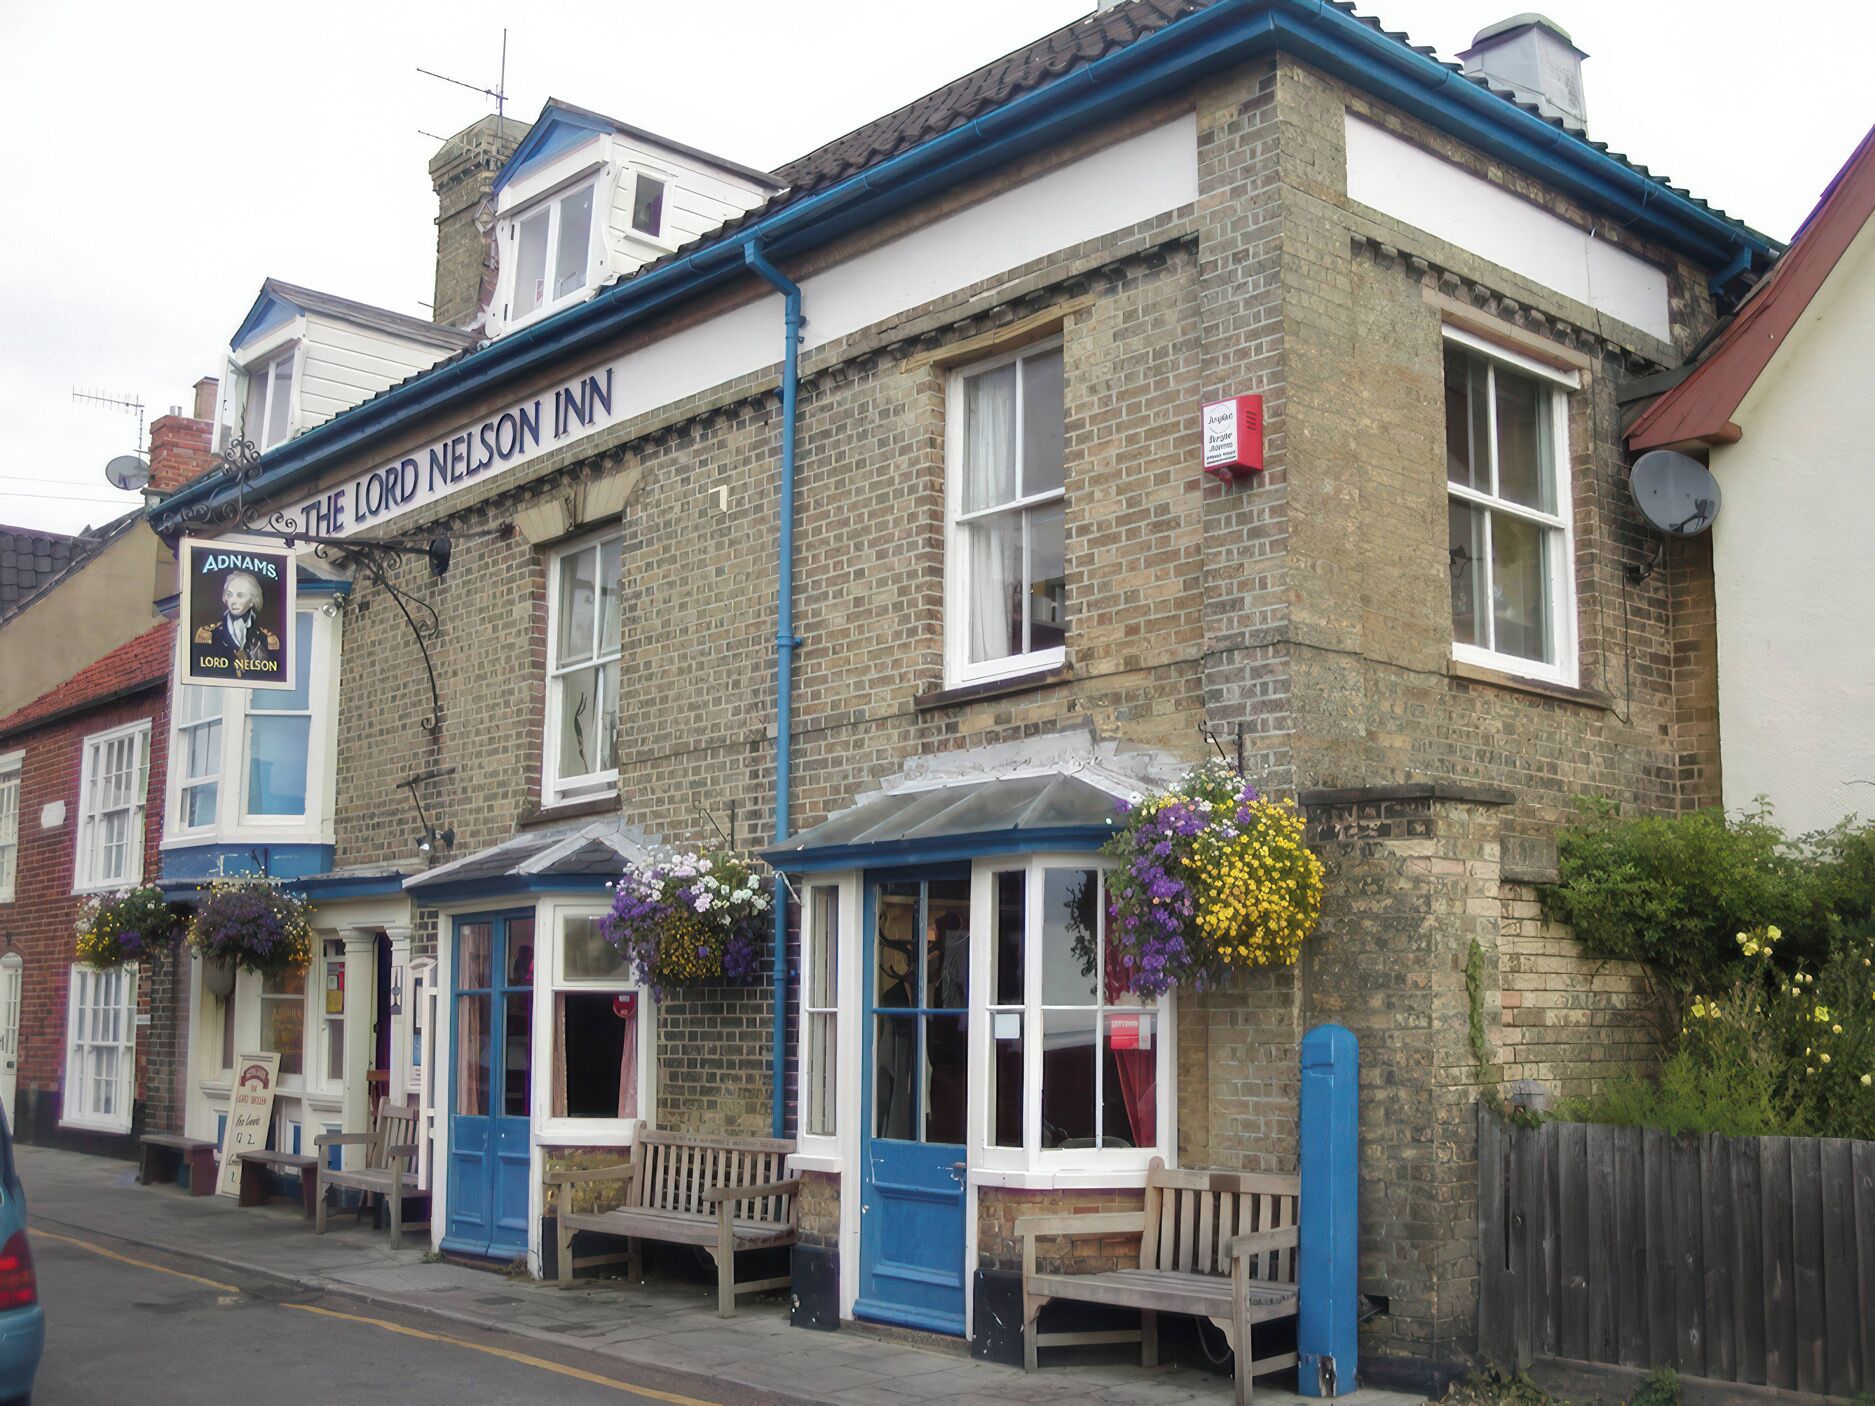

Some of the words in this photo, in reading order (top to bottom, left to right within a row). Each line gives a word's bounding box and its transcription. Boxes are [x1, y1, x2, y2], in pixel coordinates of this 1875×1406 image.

[300, 488, 346, 545] THE
[354, 456, 419, 524] LORD
[428, 399, 542, 493] NELSON
[553, 367, 613, 440] INN
[200, 656, 229, 668] LORD
[233, 658, 278, 672] NELSON
